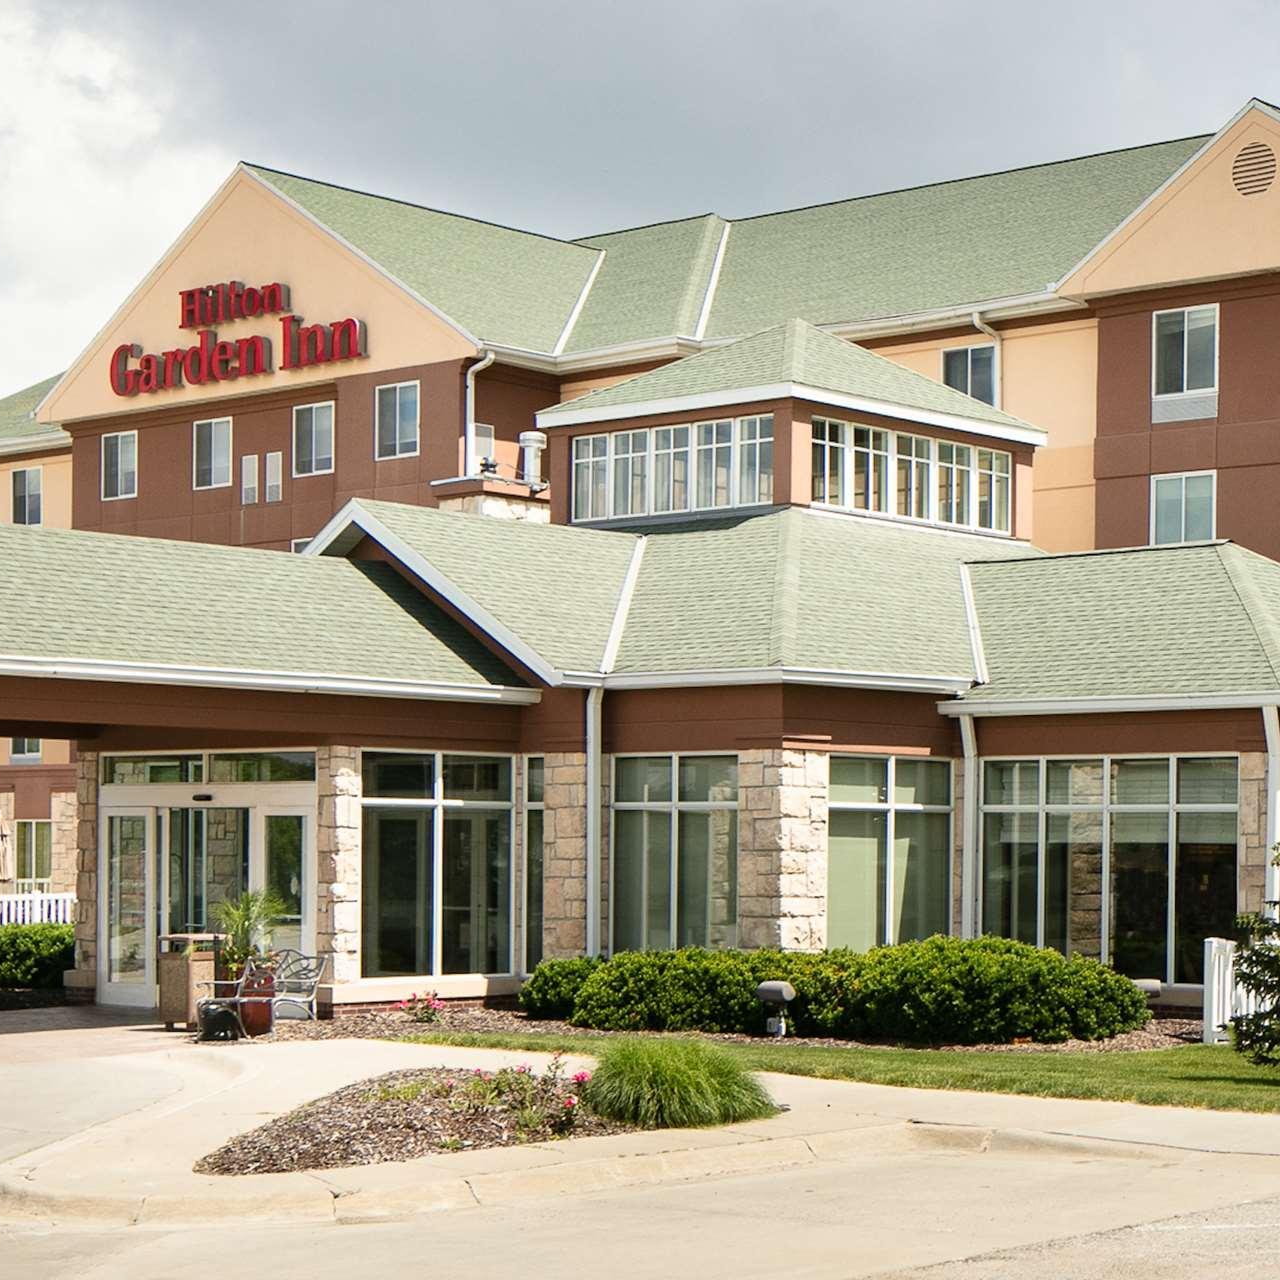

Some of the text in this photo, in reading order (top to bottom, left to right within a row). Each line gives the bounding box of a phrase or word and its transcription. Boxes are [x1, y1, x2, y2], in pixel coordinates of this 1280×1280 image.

[179, 281, 290, 328] Hilton
[110, 315, 370, 397] Garden Inn
